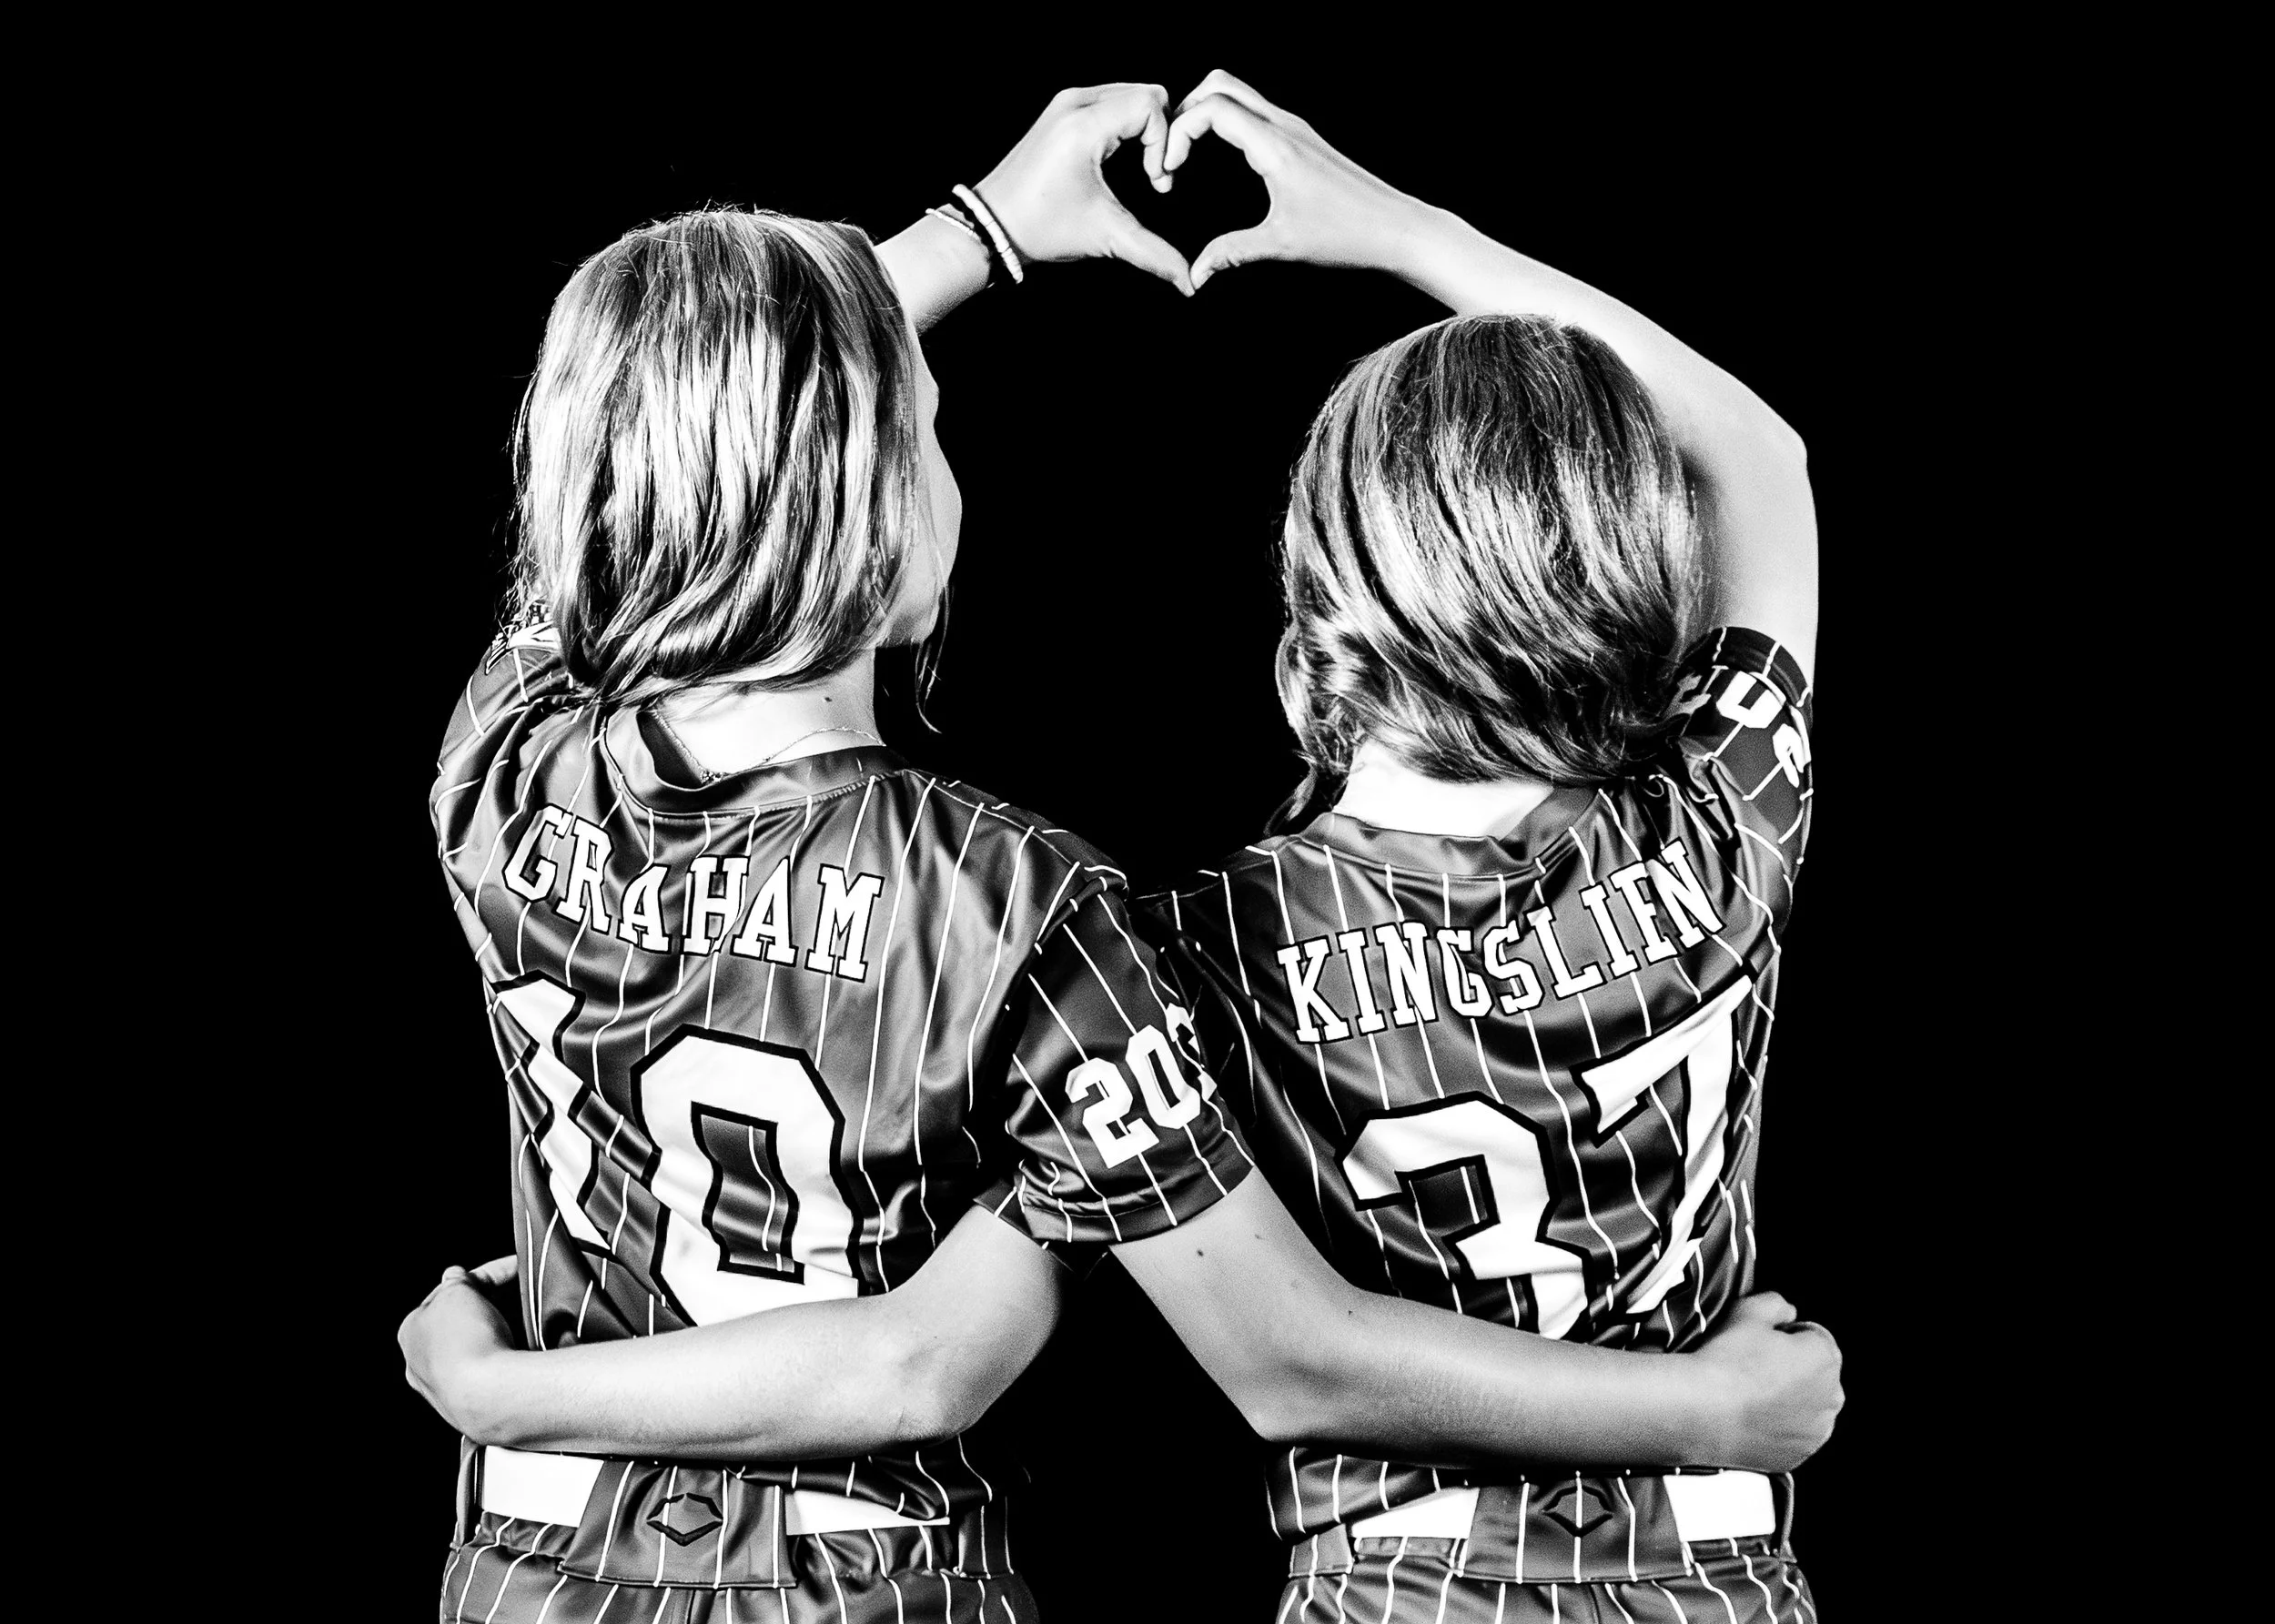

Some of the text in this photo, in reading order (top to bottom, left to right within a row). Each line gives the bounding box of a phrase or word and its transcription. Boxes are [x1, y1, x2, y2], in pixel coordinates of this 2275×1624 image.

[502, 802, 885, 982] GRAHAM
[491, 970, 870, 1328] 10
[1333, 971, 1756, 1341] 37
